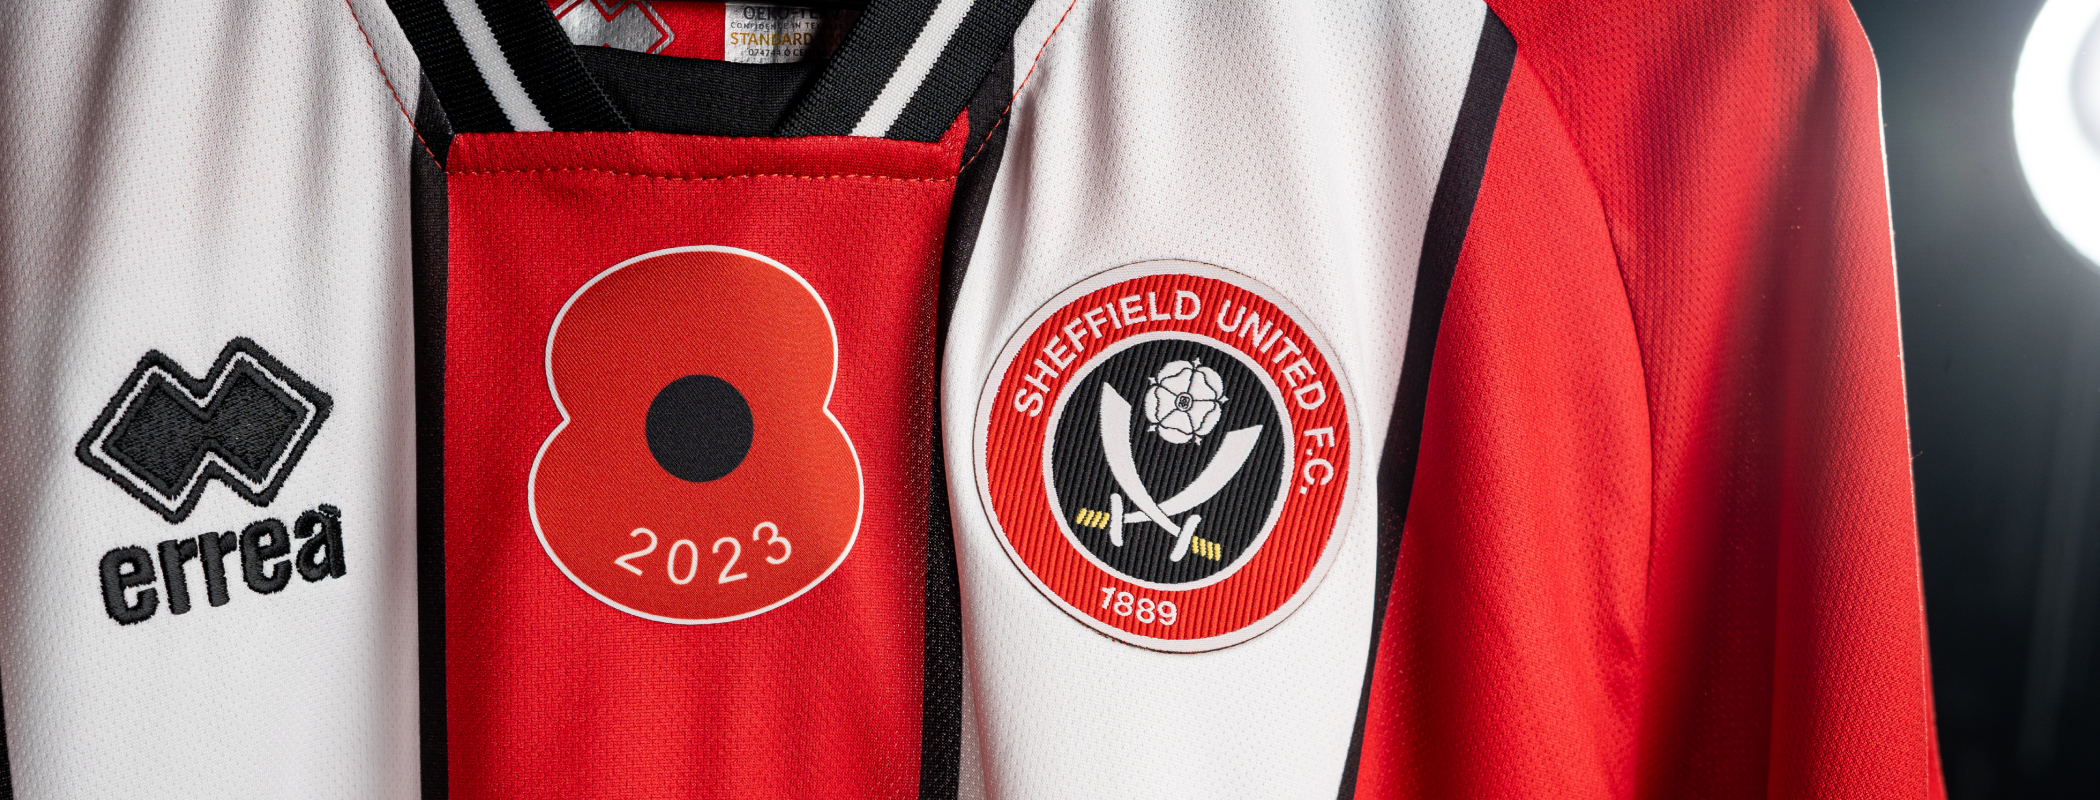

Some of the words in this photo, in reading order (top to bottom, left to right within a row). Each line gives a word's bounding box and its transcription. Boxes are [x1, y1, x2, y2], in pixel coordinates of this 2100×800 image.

[730, 32, 814, 46] STANDARD
[1015, 290, 1201, 417] SHEFFIELD
[1216, 299, 1326, 411] UNITED
[1299, 426, 1335, 495] F.C.
[614, 521, 792, 585] 2023
[1100, 586, 1178, 626] 1889
